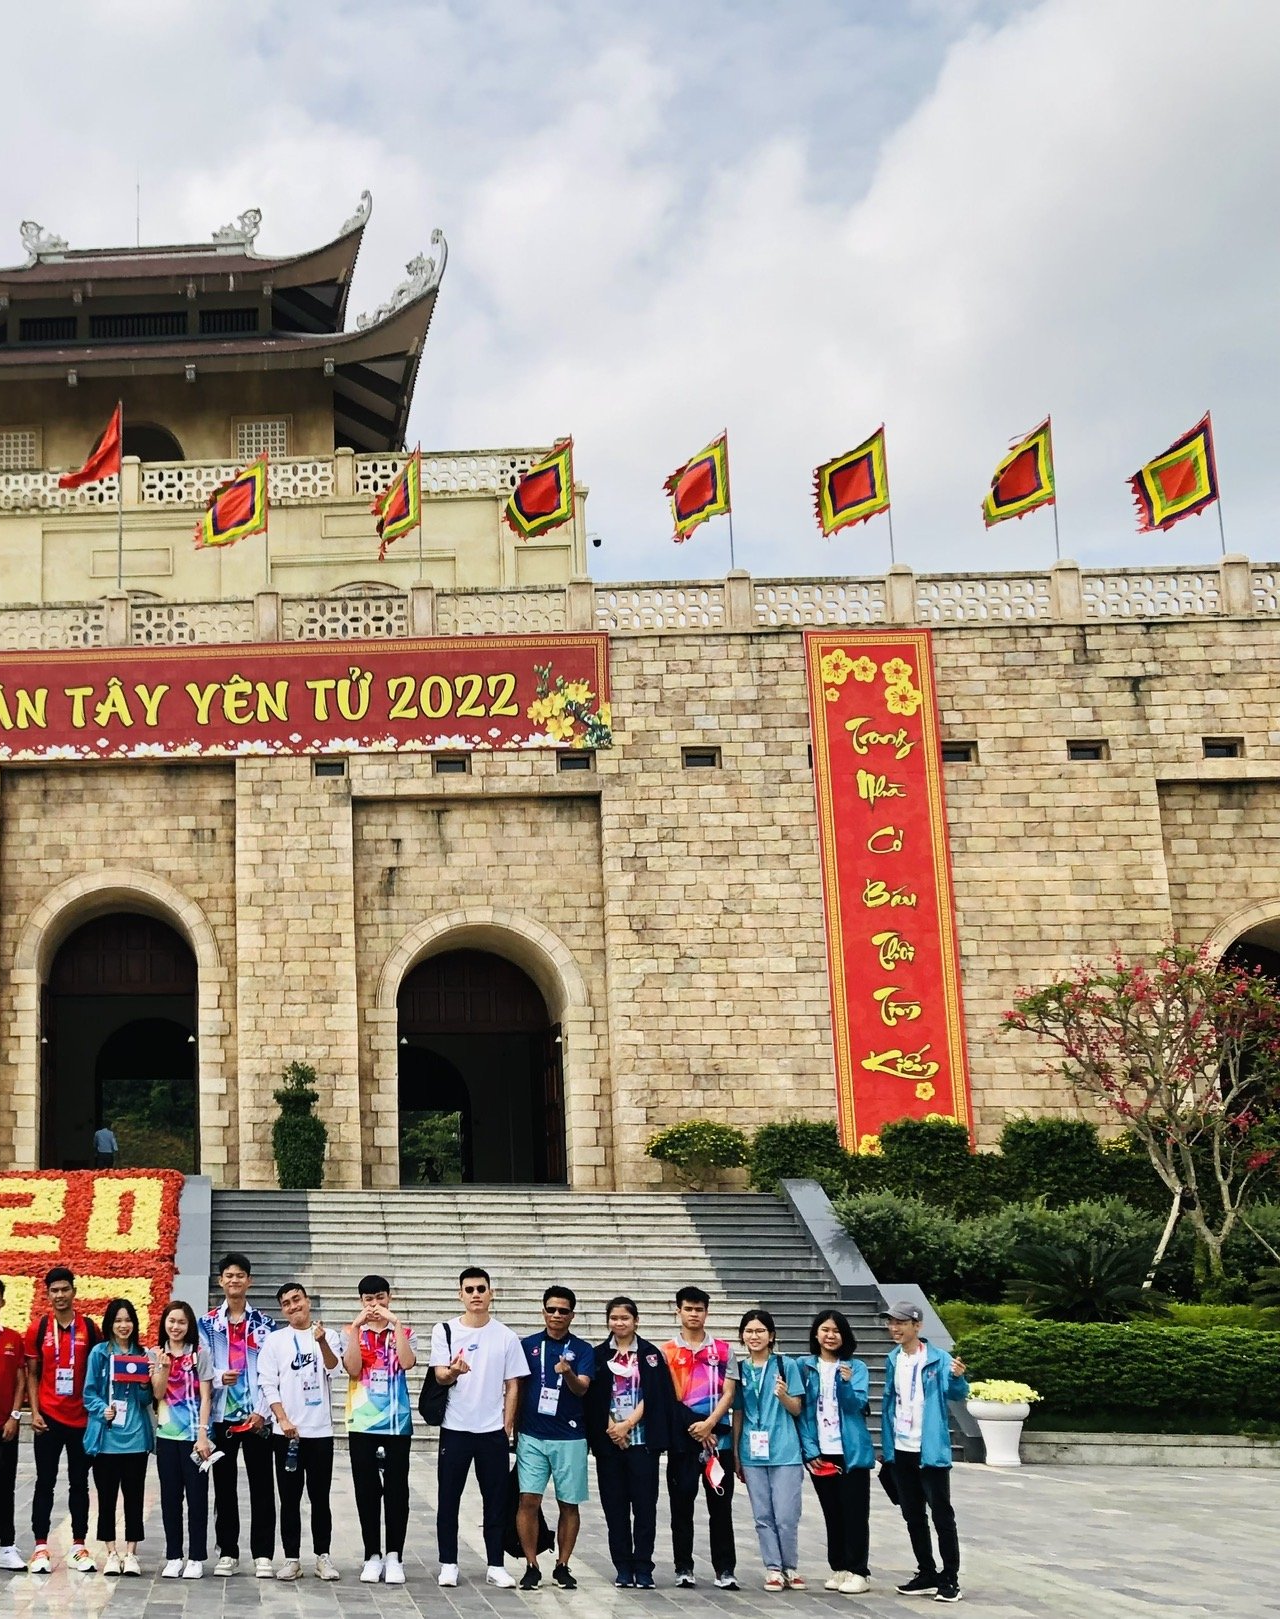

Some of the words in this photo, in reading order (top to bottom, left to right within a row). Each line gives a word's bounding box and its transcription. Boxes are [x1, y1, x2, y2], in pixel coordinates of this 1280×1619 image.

[64, 677, 170, 728] TÂY
[185, 674, 289, 725] YÊN
[305, 666, 373, 721] TỬ
[387, 673, 519, 721] 2022
[844, 716, 916, 760] Trong
[856, 768, 907, 806] Nhà
[867, 825, 904, 854] Có
[862, 878, 917, 908] Báu
[871, 931, 915, 971] Thôi
[872, 986, 922, 1027] Tìm
[860, 1043, 940, 1080] Kiếm
